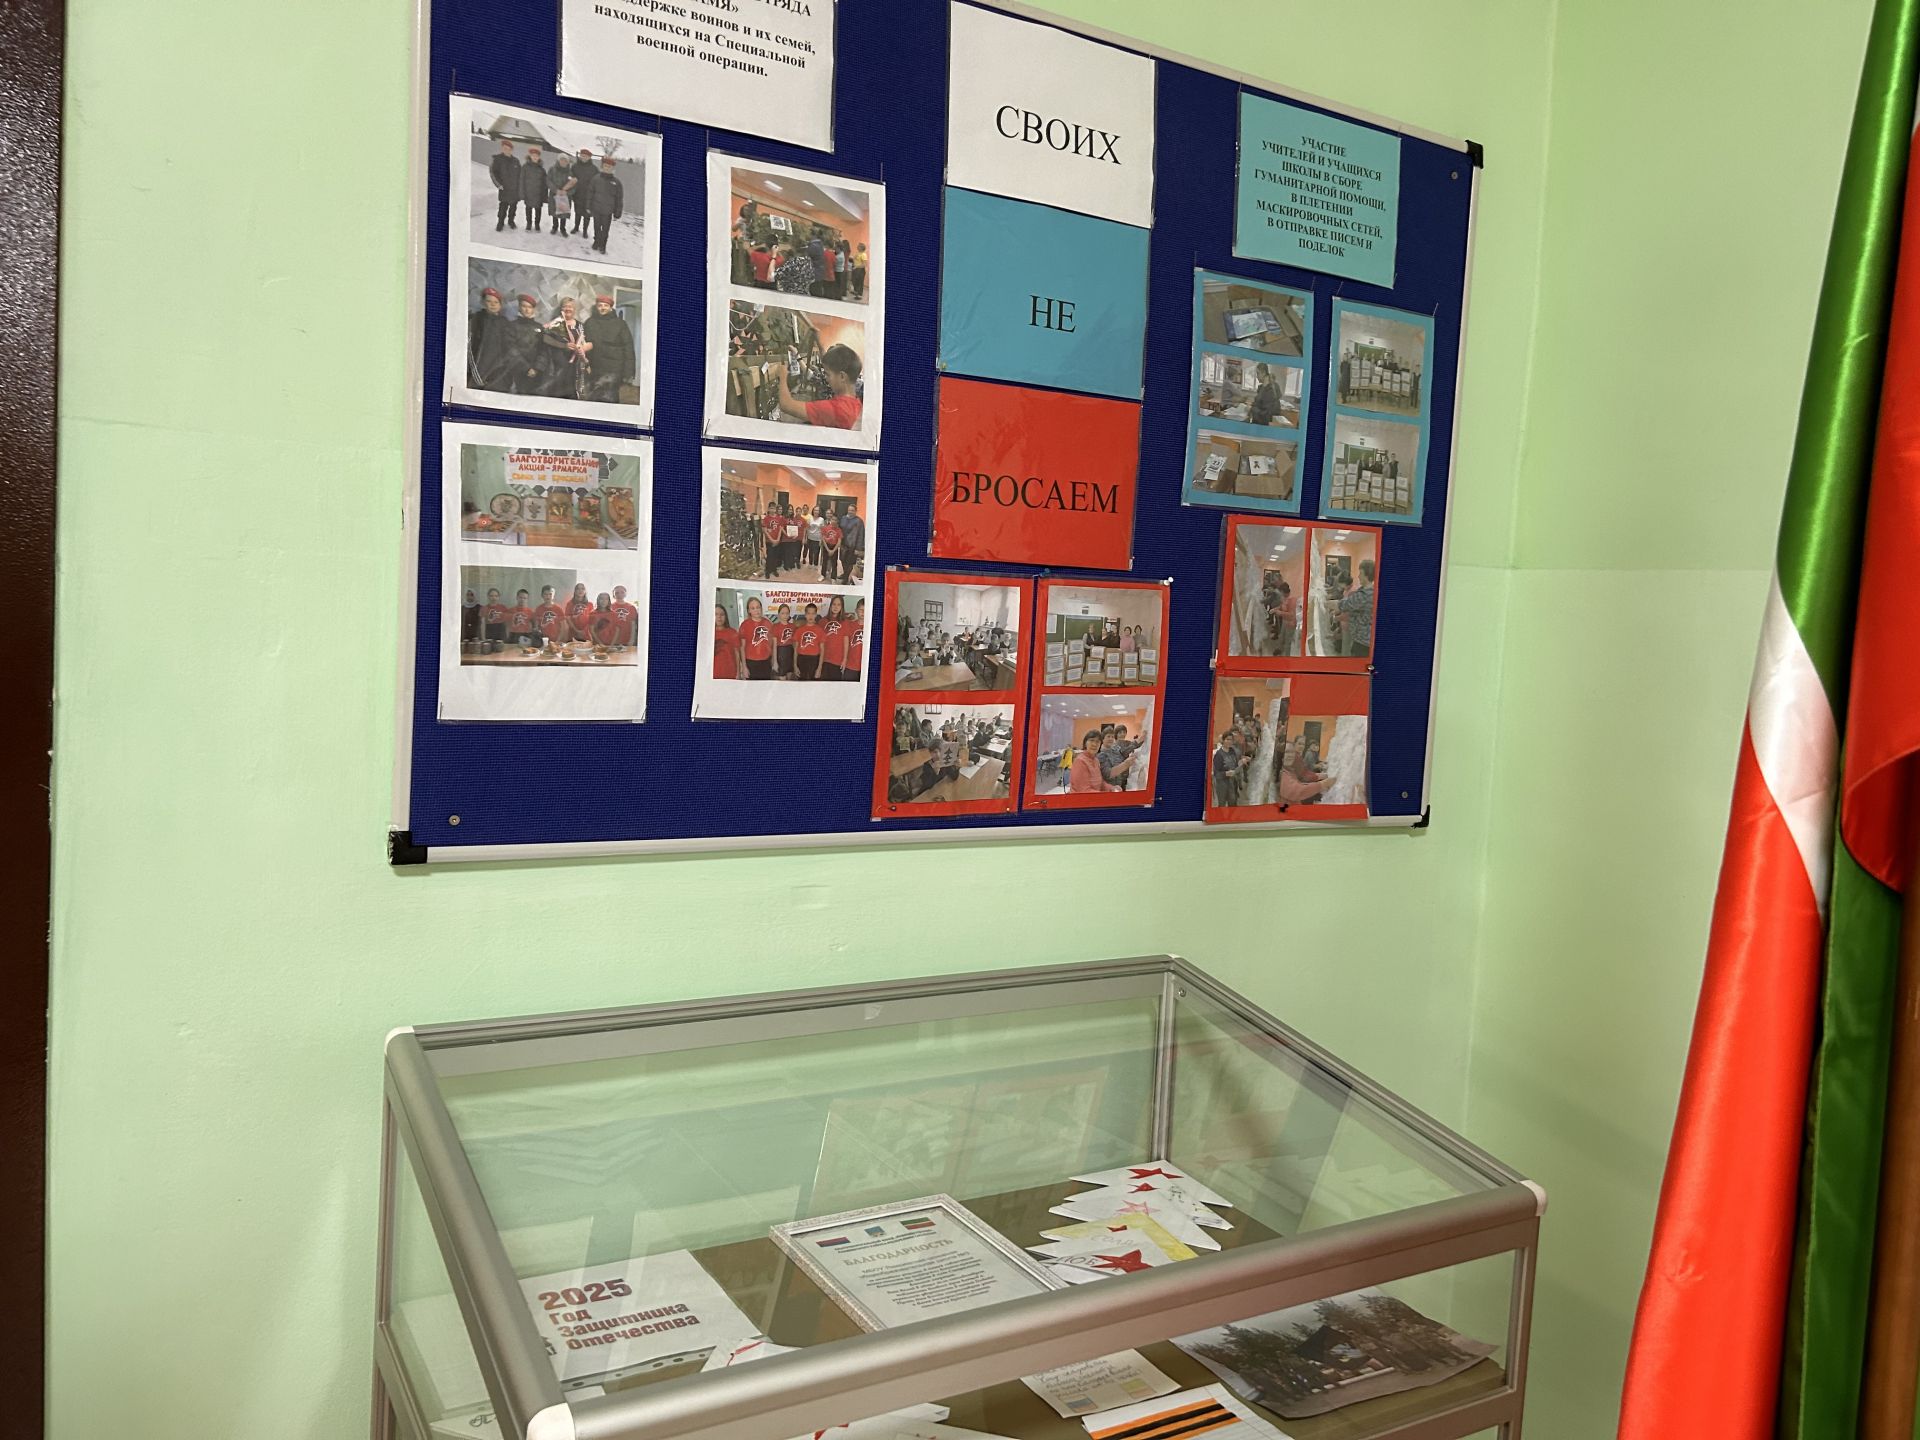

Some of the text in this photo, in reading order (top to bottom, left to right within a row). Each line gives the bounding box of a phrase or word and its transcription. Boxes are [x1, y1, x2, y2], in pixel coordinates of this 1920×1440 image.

[594, 4, 806, 68] находящихся на Специальной
[690, 11, 739, 32] воинов
[743, 25, 751, 36] и
[755, 29, 771, 41] их
[775, 34, 816, 55] семей,
[637, 34, 768, 77] военной операции.
[996, 105, 1122, 165] СВОИХ
[1301, 136, 1346, 157] УЧАСТИЕ
[1262, 140, 1382, 181] УЧИТЕЛЕЙ И УЧАЩИХСЯ
[1282, 161, 1363, 191] ШКОЛЫ В СБОРЕ
[1254, 168, 1337, 197] ГУМАНИТАРНОЙ
[1256, 199, 1349, 230] МАСКИРОВОЧНЫХ
[1291, 193, 1353, 217] В ПЛЕТЕНИИ
[1267, 217, 1372, 250] В ОТПРАВКЕ ПИСЕМ И
[1298, 238, 1345, 257] ПОДЕЛОК
[1028, 294, 1077, 333] НЕ
[951, 471, 1120, 514] БРОСАЕМ
[843, 1239, 953, 1266] БЛАГОДАРНОСТЬ
[538, 1278, 632, 1310] 2025
[549, 1309, 592, 1325] Год
[558, 1303, 690, 1338] Защитника
[565, 1315, 700, 1350] Отечества
